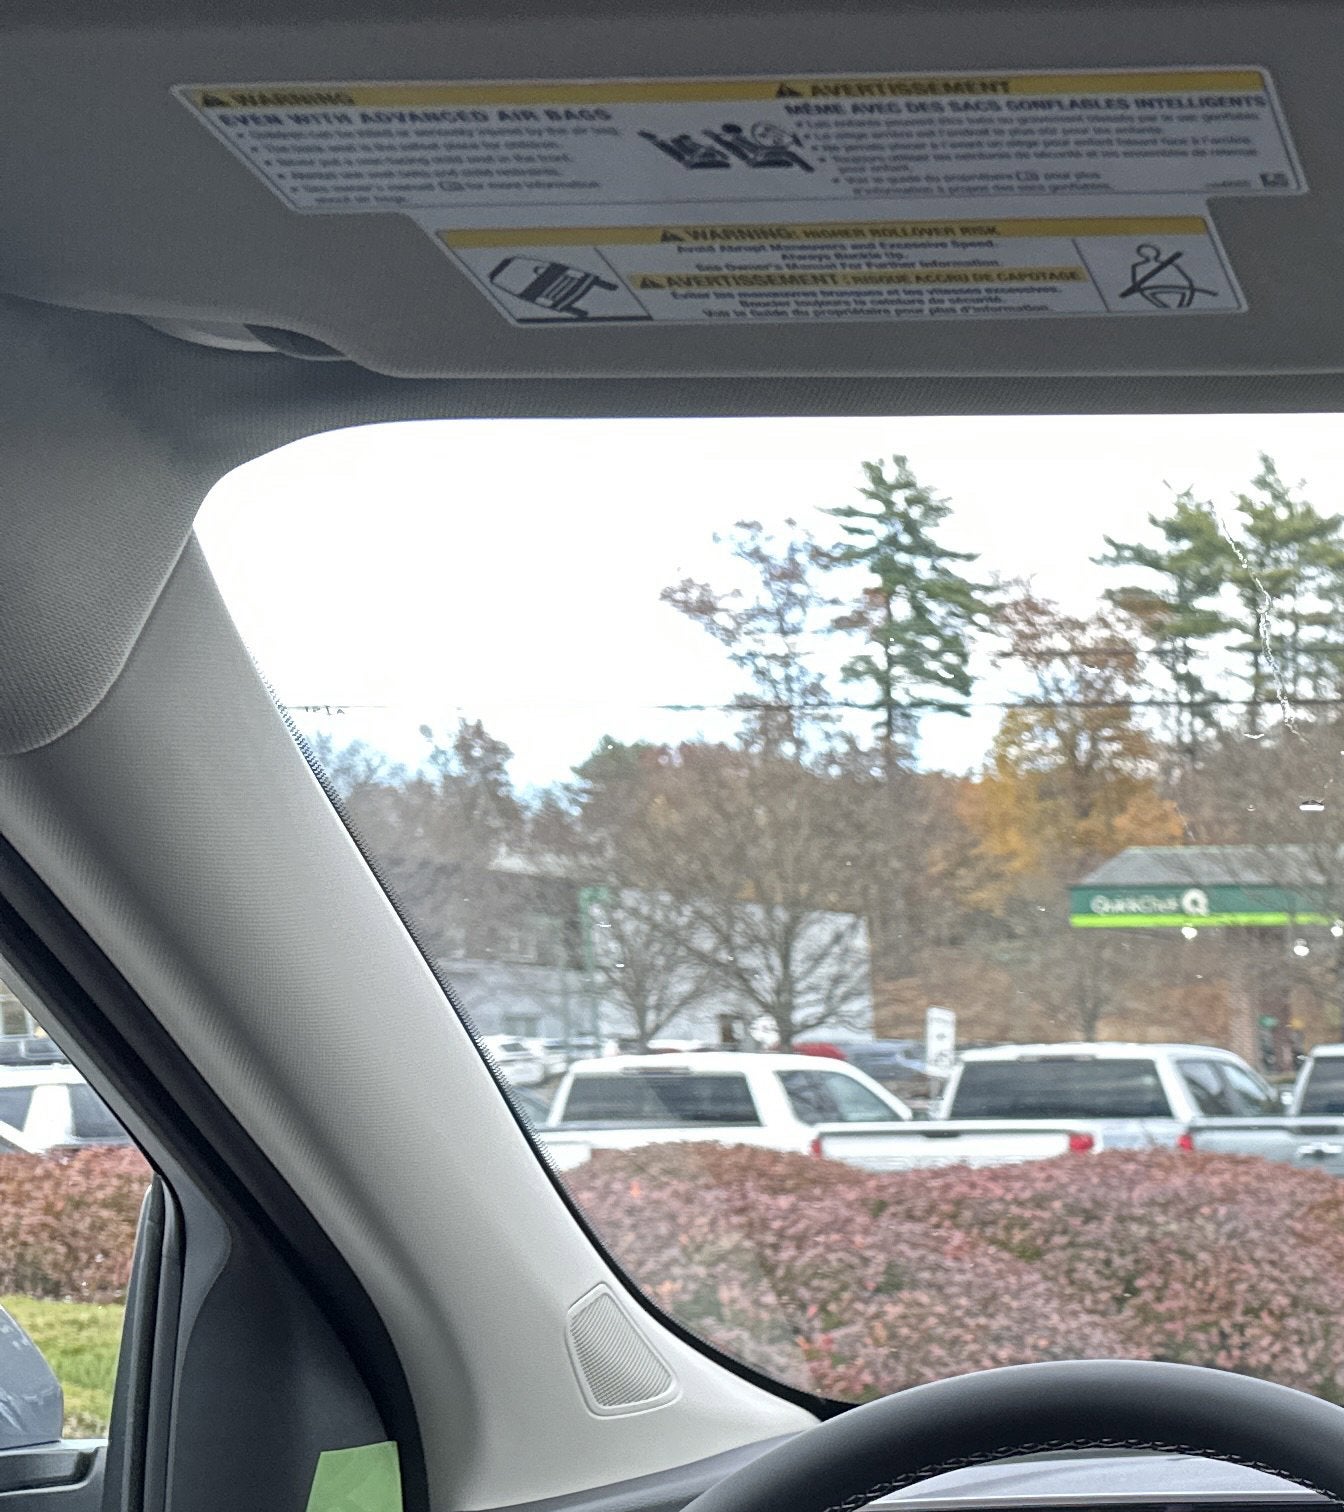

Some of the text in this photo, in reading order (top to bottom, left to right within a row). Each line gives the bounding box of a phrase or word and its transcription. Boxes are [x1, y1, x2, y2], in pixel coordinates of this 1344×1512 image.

[811, 81, 1009, 97] AVERTISSEMENT
[231, 90, 355, 106] WARNING
[905, 101, 945, 113] DES
[947, 99, 1003, 113] SACS
[1134, 95, 1266, 110] INTELLIGENTS
[219, 108, 613, 126] EVEN WITH ADVANCED AIR BAGS
[959, 225, 999, 237] RISK
[667, 273, 841, 289] AVERTISSEMENT
